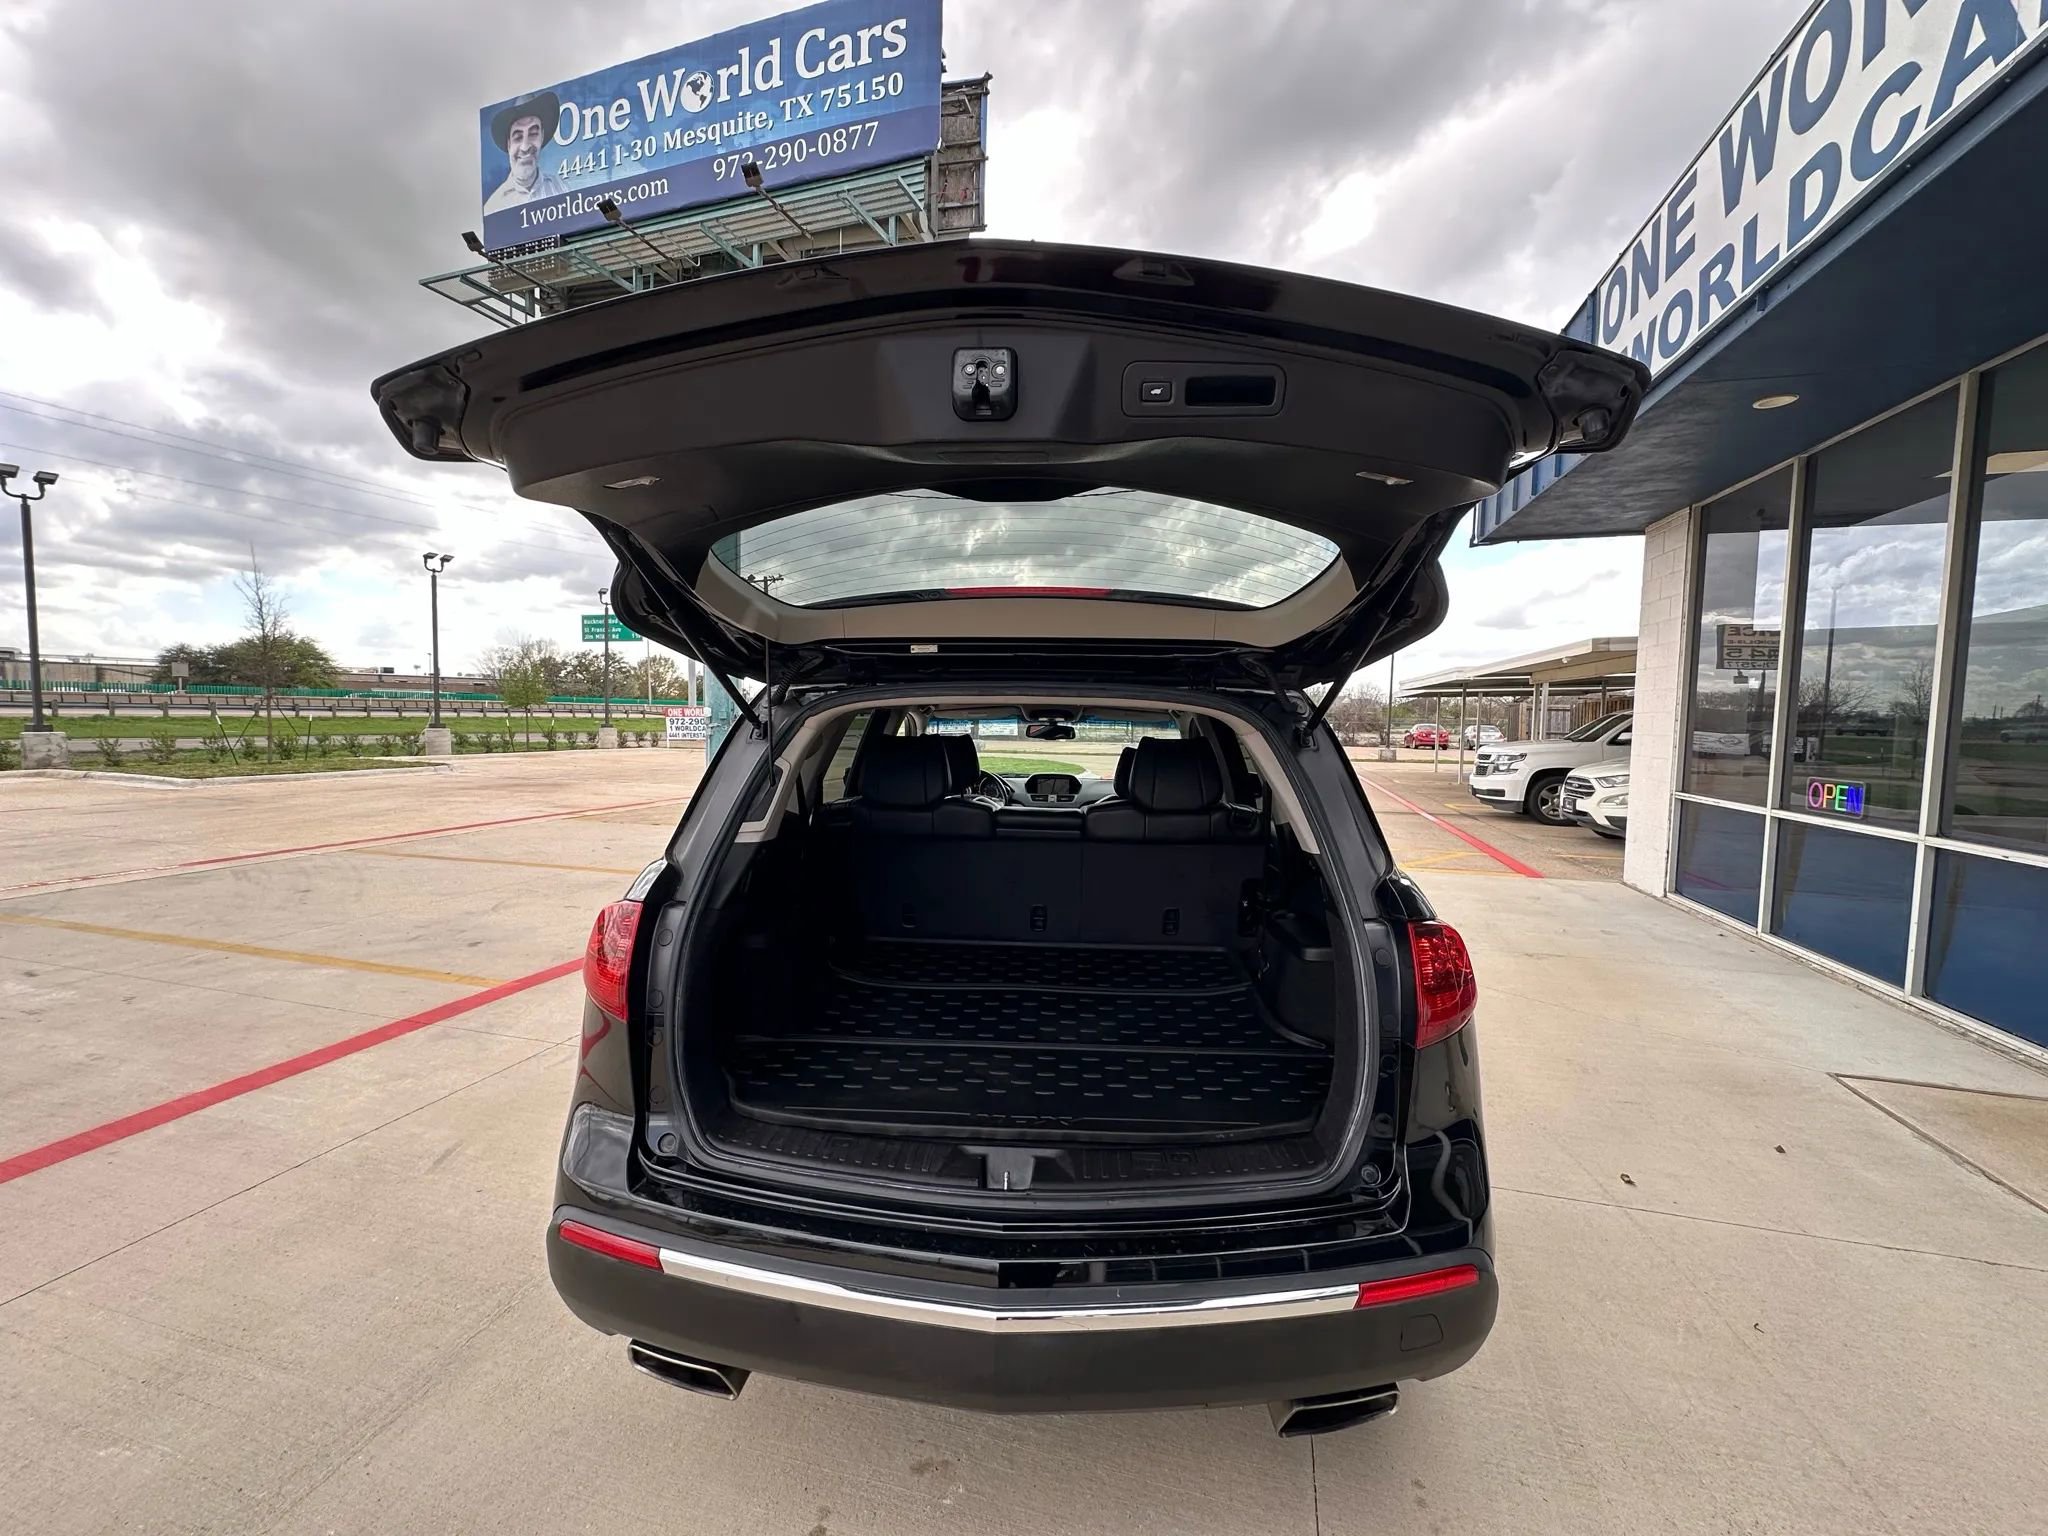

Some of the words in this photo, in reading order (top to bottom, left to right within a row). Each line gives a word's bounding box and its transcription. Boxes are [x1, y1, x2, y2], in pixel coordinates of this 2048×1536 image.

[554, 98, 631, 147] One
[637, 38, 784, 123] World
[795, 18, 908, 80] Cars
[557, 147, 610, 180] 4441
[615, 134, 657, 166] I-30
[663, 108, 775, 156] Mesquite,
[779, 94, 814, 122] TX
[821, 72, 905, 114] 75150
[1603, 168, 1698, 345] ONE
[667, 707, 683, 716] ONE
[1809, 782, 1863, 814] OPEN
